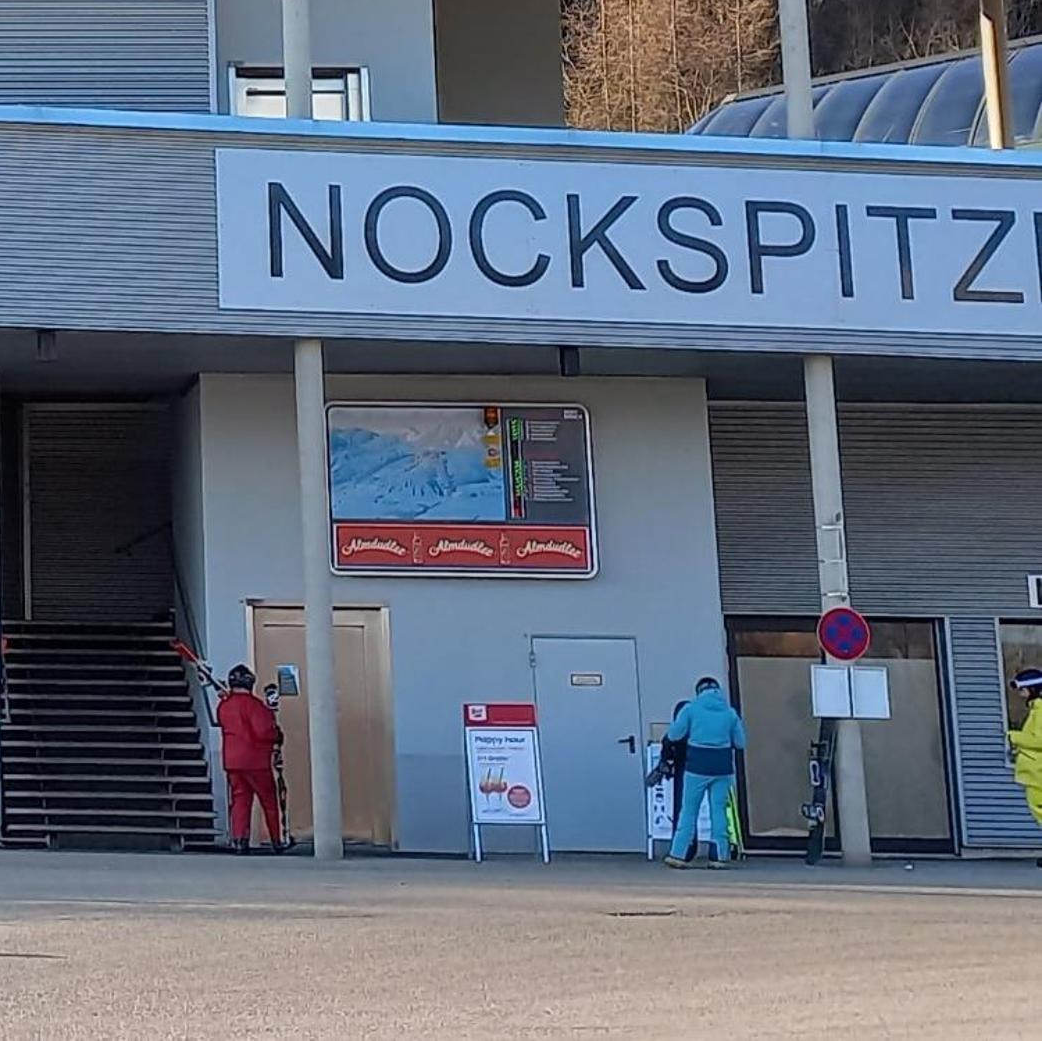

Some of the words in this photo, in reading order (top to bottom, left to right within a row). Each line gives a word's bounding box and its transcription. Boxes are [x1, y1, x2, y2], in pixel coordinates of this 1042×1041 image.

[341, 537, 407, 556] Almdudler
[428, 537, 494, 558] Almdudler
[516, 538, 582, 559] Almdudler
